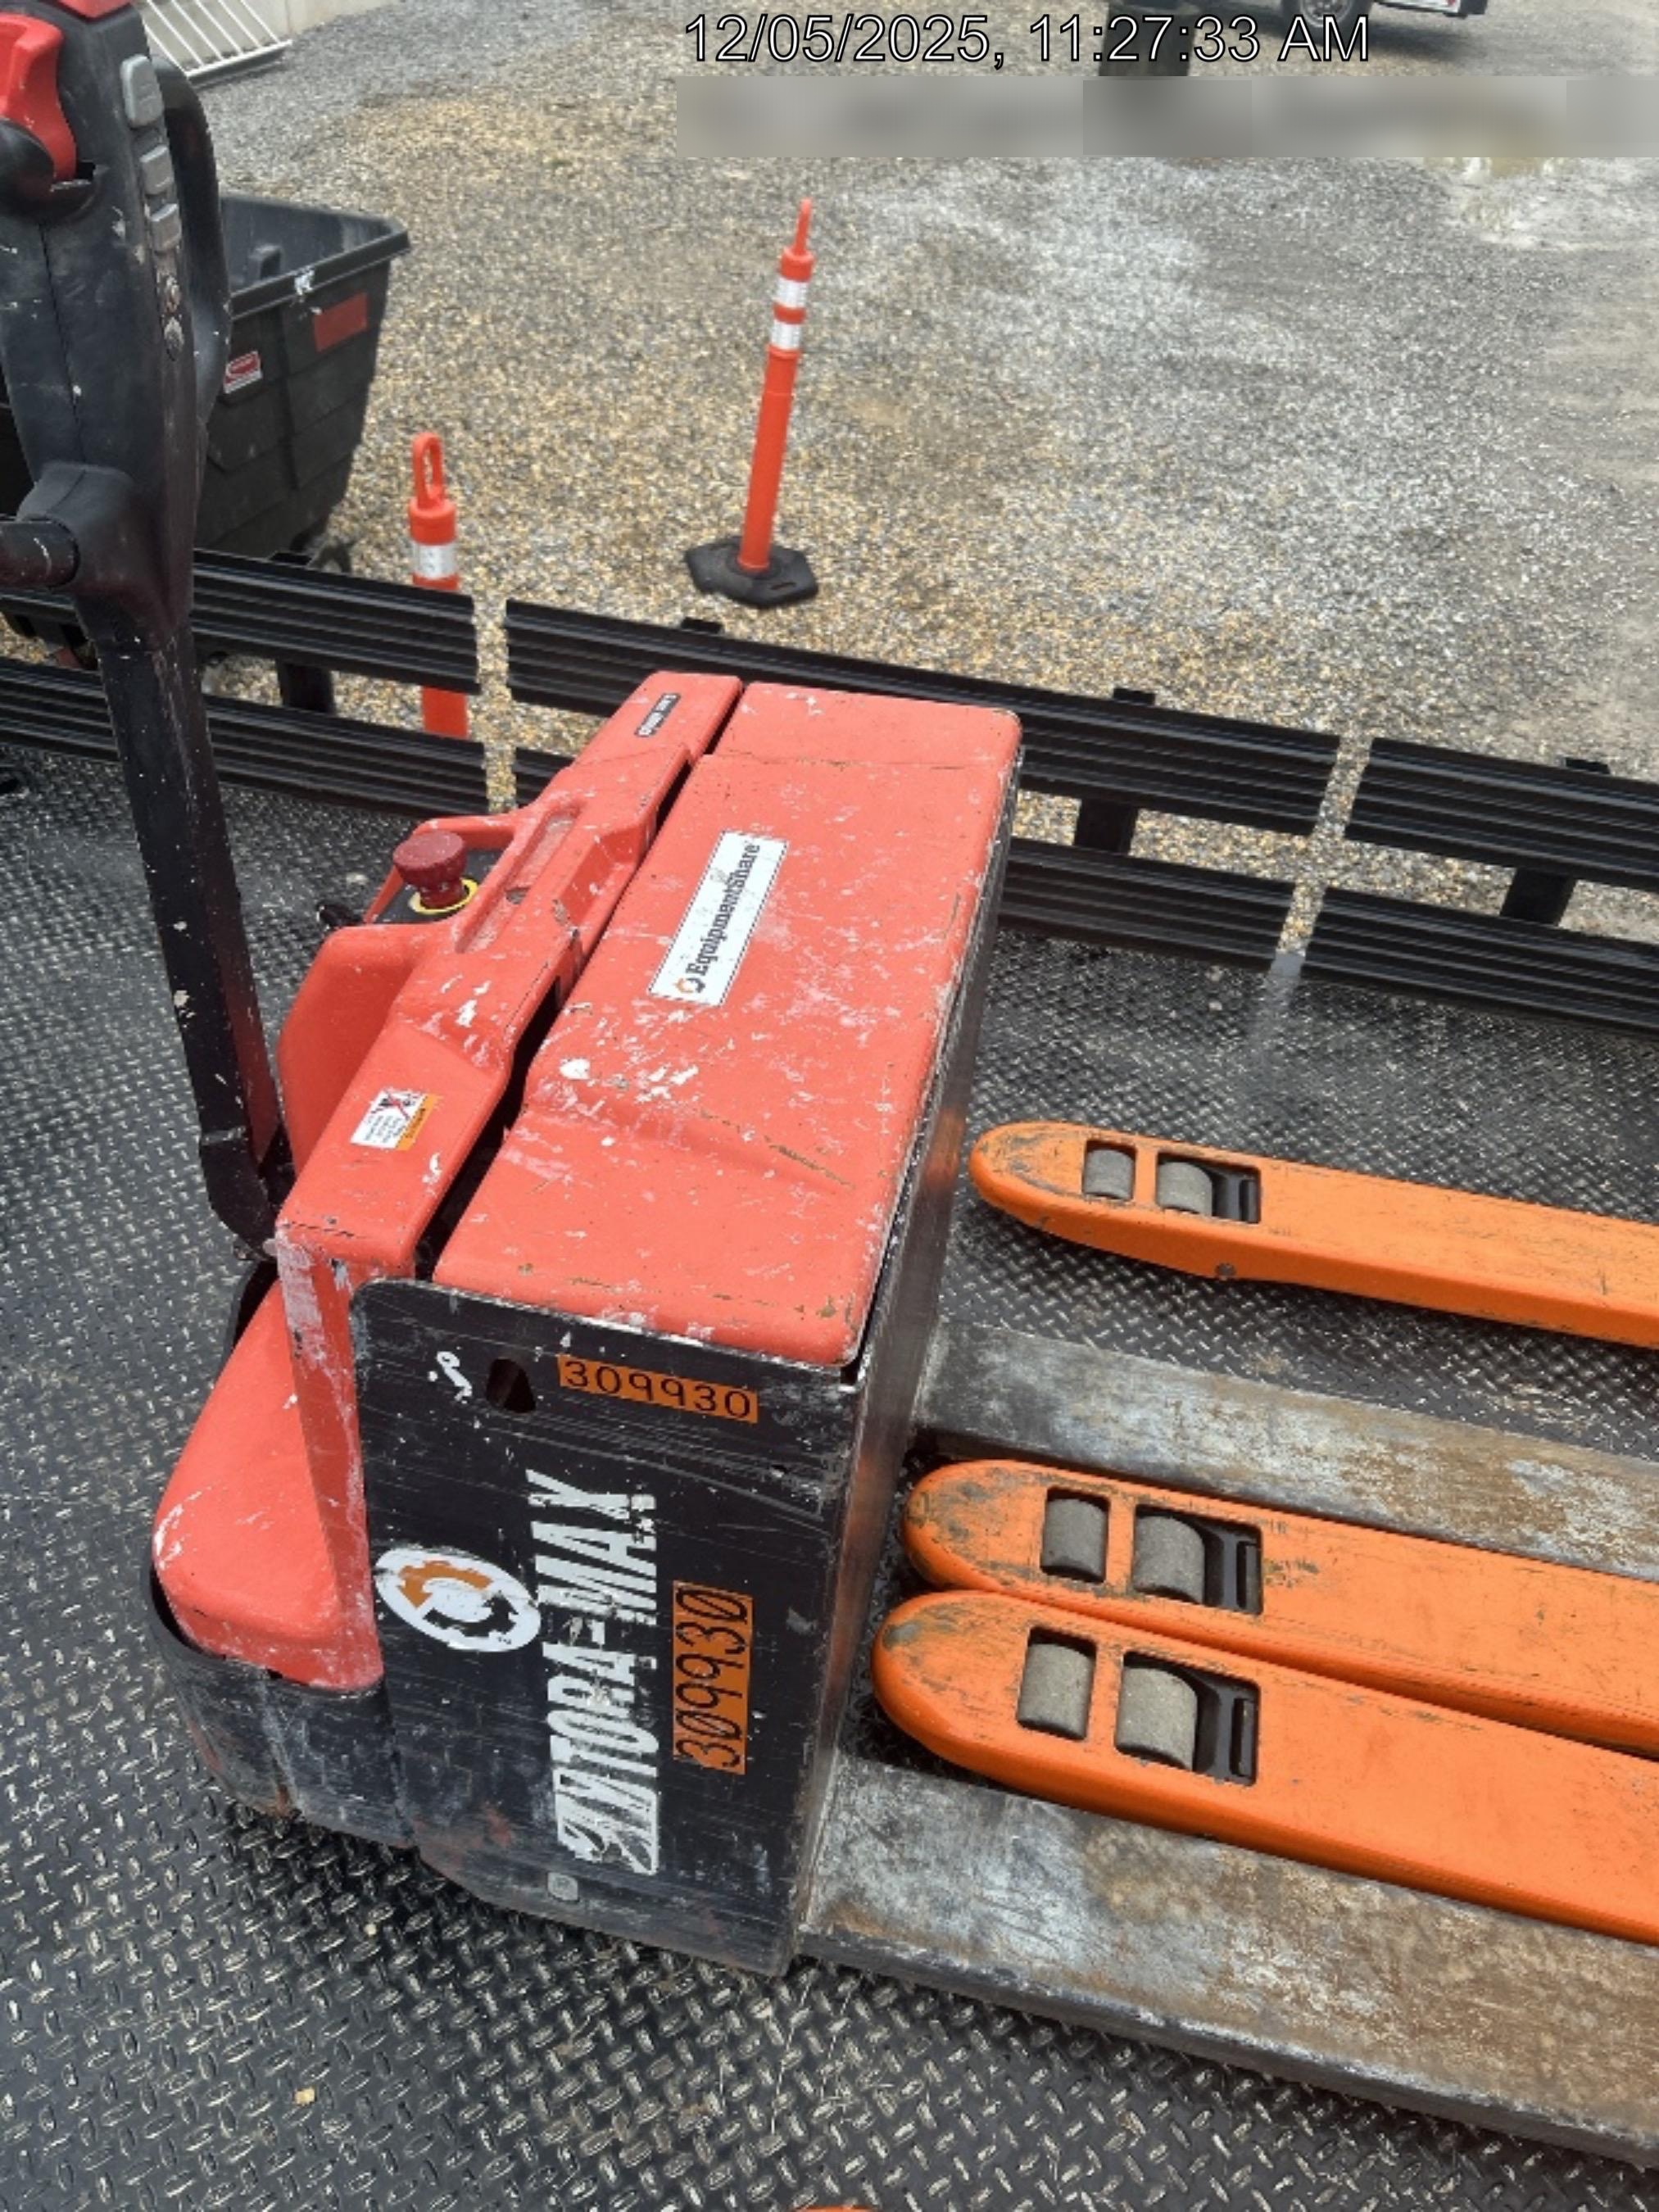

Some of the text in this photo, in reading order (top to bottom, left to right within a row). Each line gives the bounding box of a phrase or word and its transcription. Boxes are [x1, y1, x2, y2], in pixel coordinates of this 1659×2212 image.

[686, 842, 760, 976] EquipmentShare
[564, 1360, 751, 1420] 309930
[675, 1587, 748, 1768] 309930
